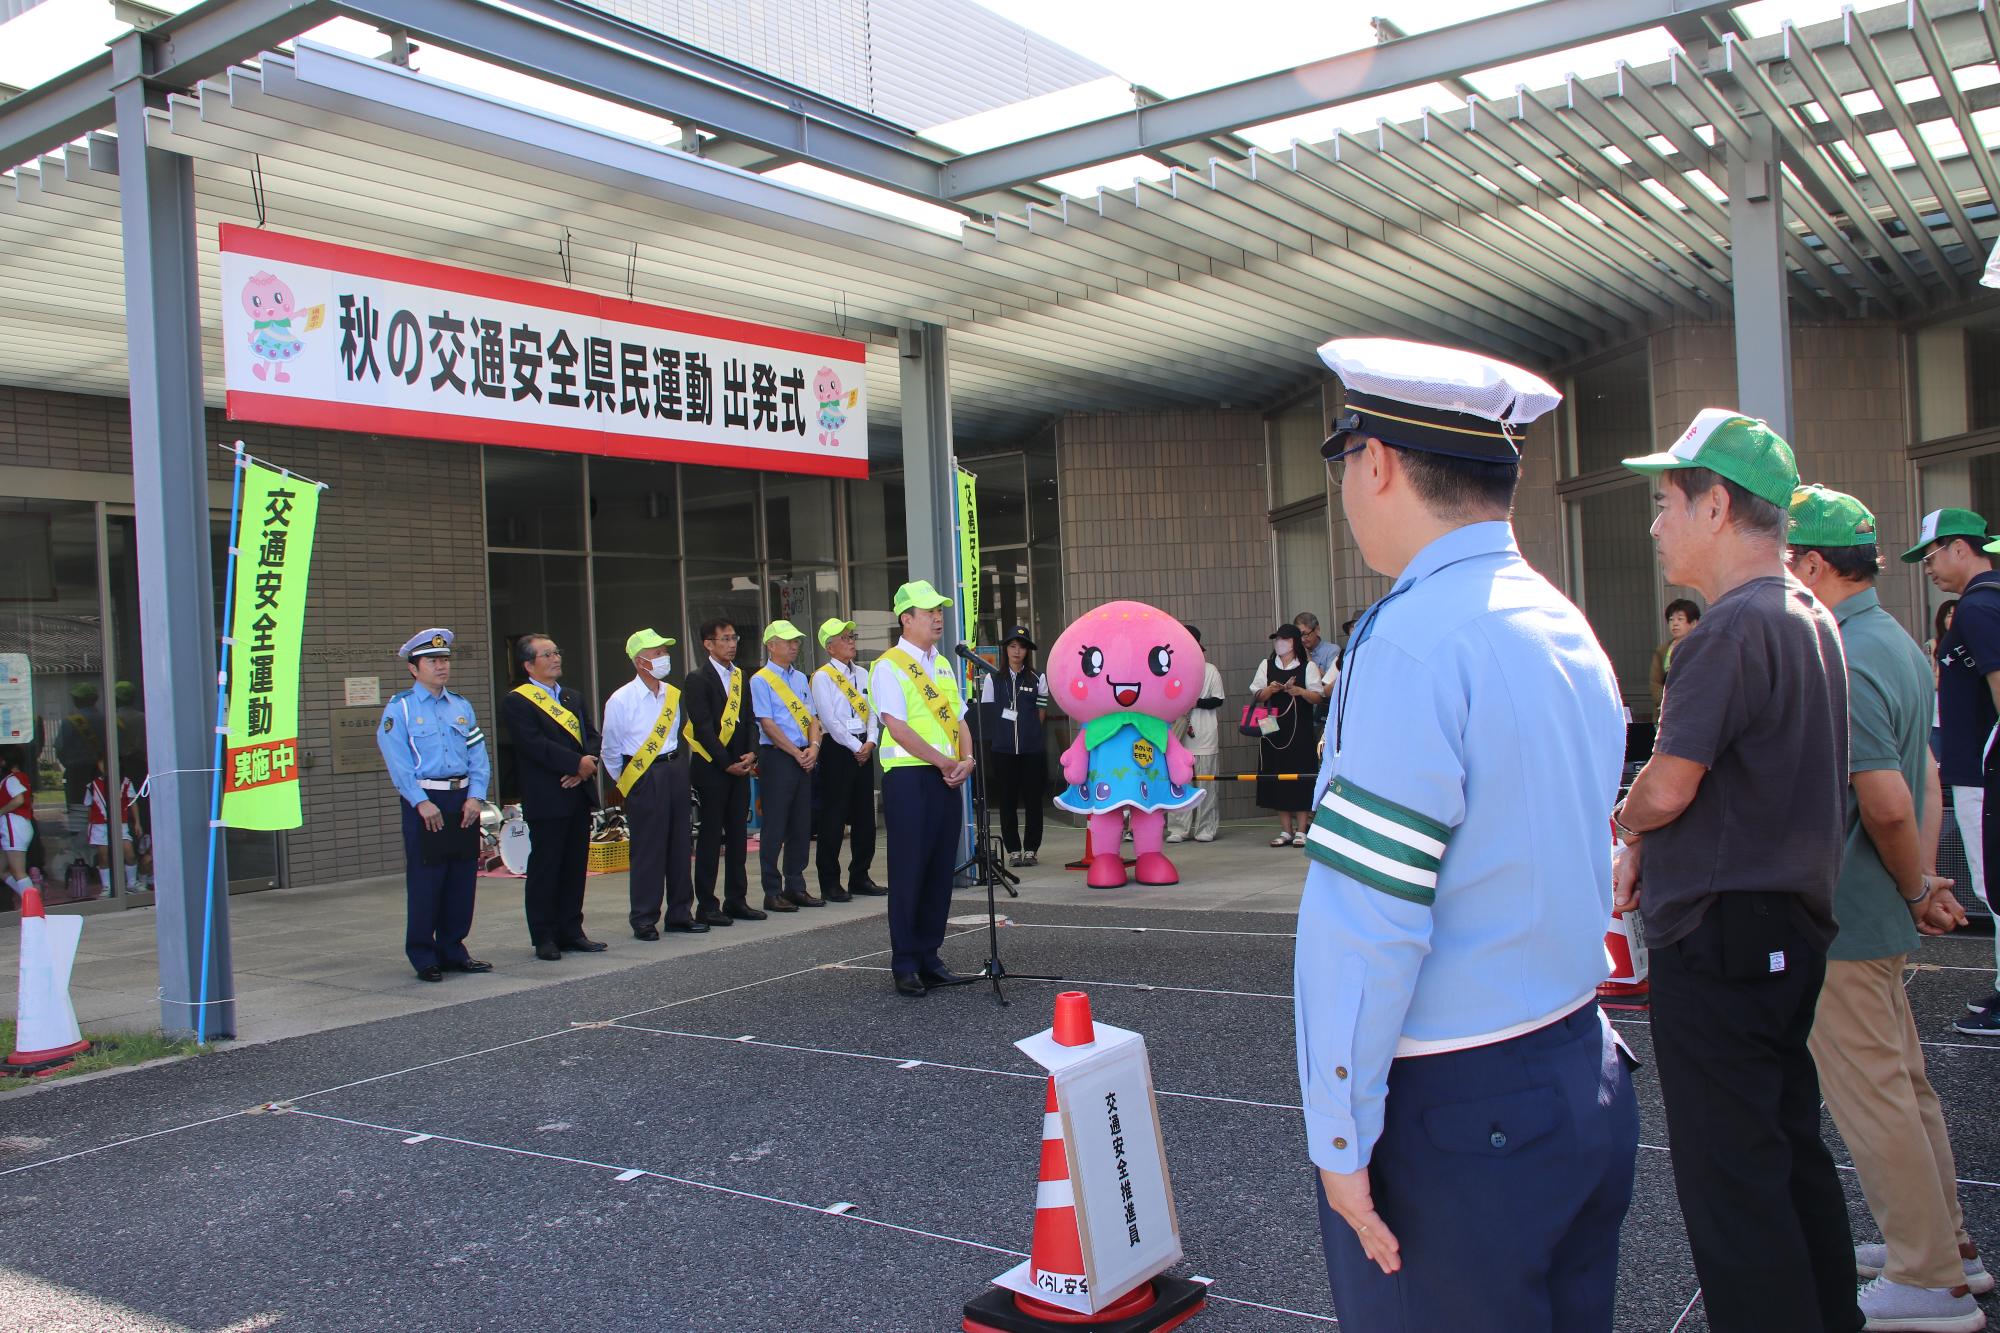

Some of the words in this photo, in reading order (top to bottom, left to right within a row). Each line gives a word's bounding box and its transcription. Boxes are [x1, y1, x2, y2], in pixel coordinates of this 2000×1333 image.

[338, 294, 713, 426] 秋の交通安全県民運動
[723, 357, 807, 438] 出発式
[247, 487, 296, 738] 交通安全運動
[234, 743, 295, 788] 実施中
[1105, 1091, 1141, 1249] 交通安全推進員
